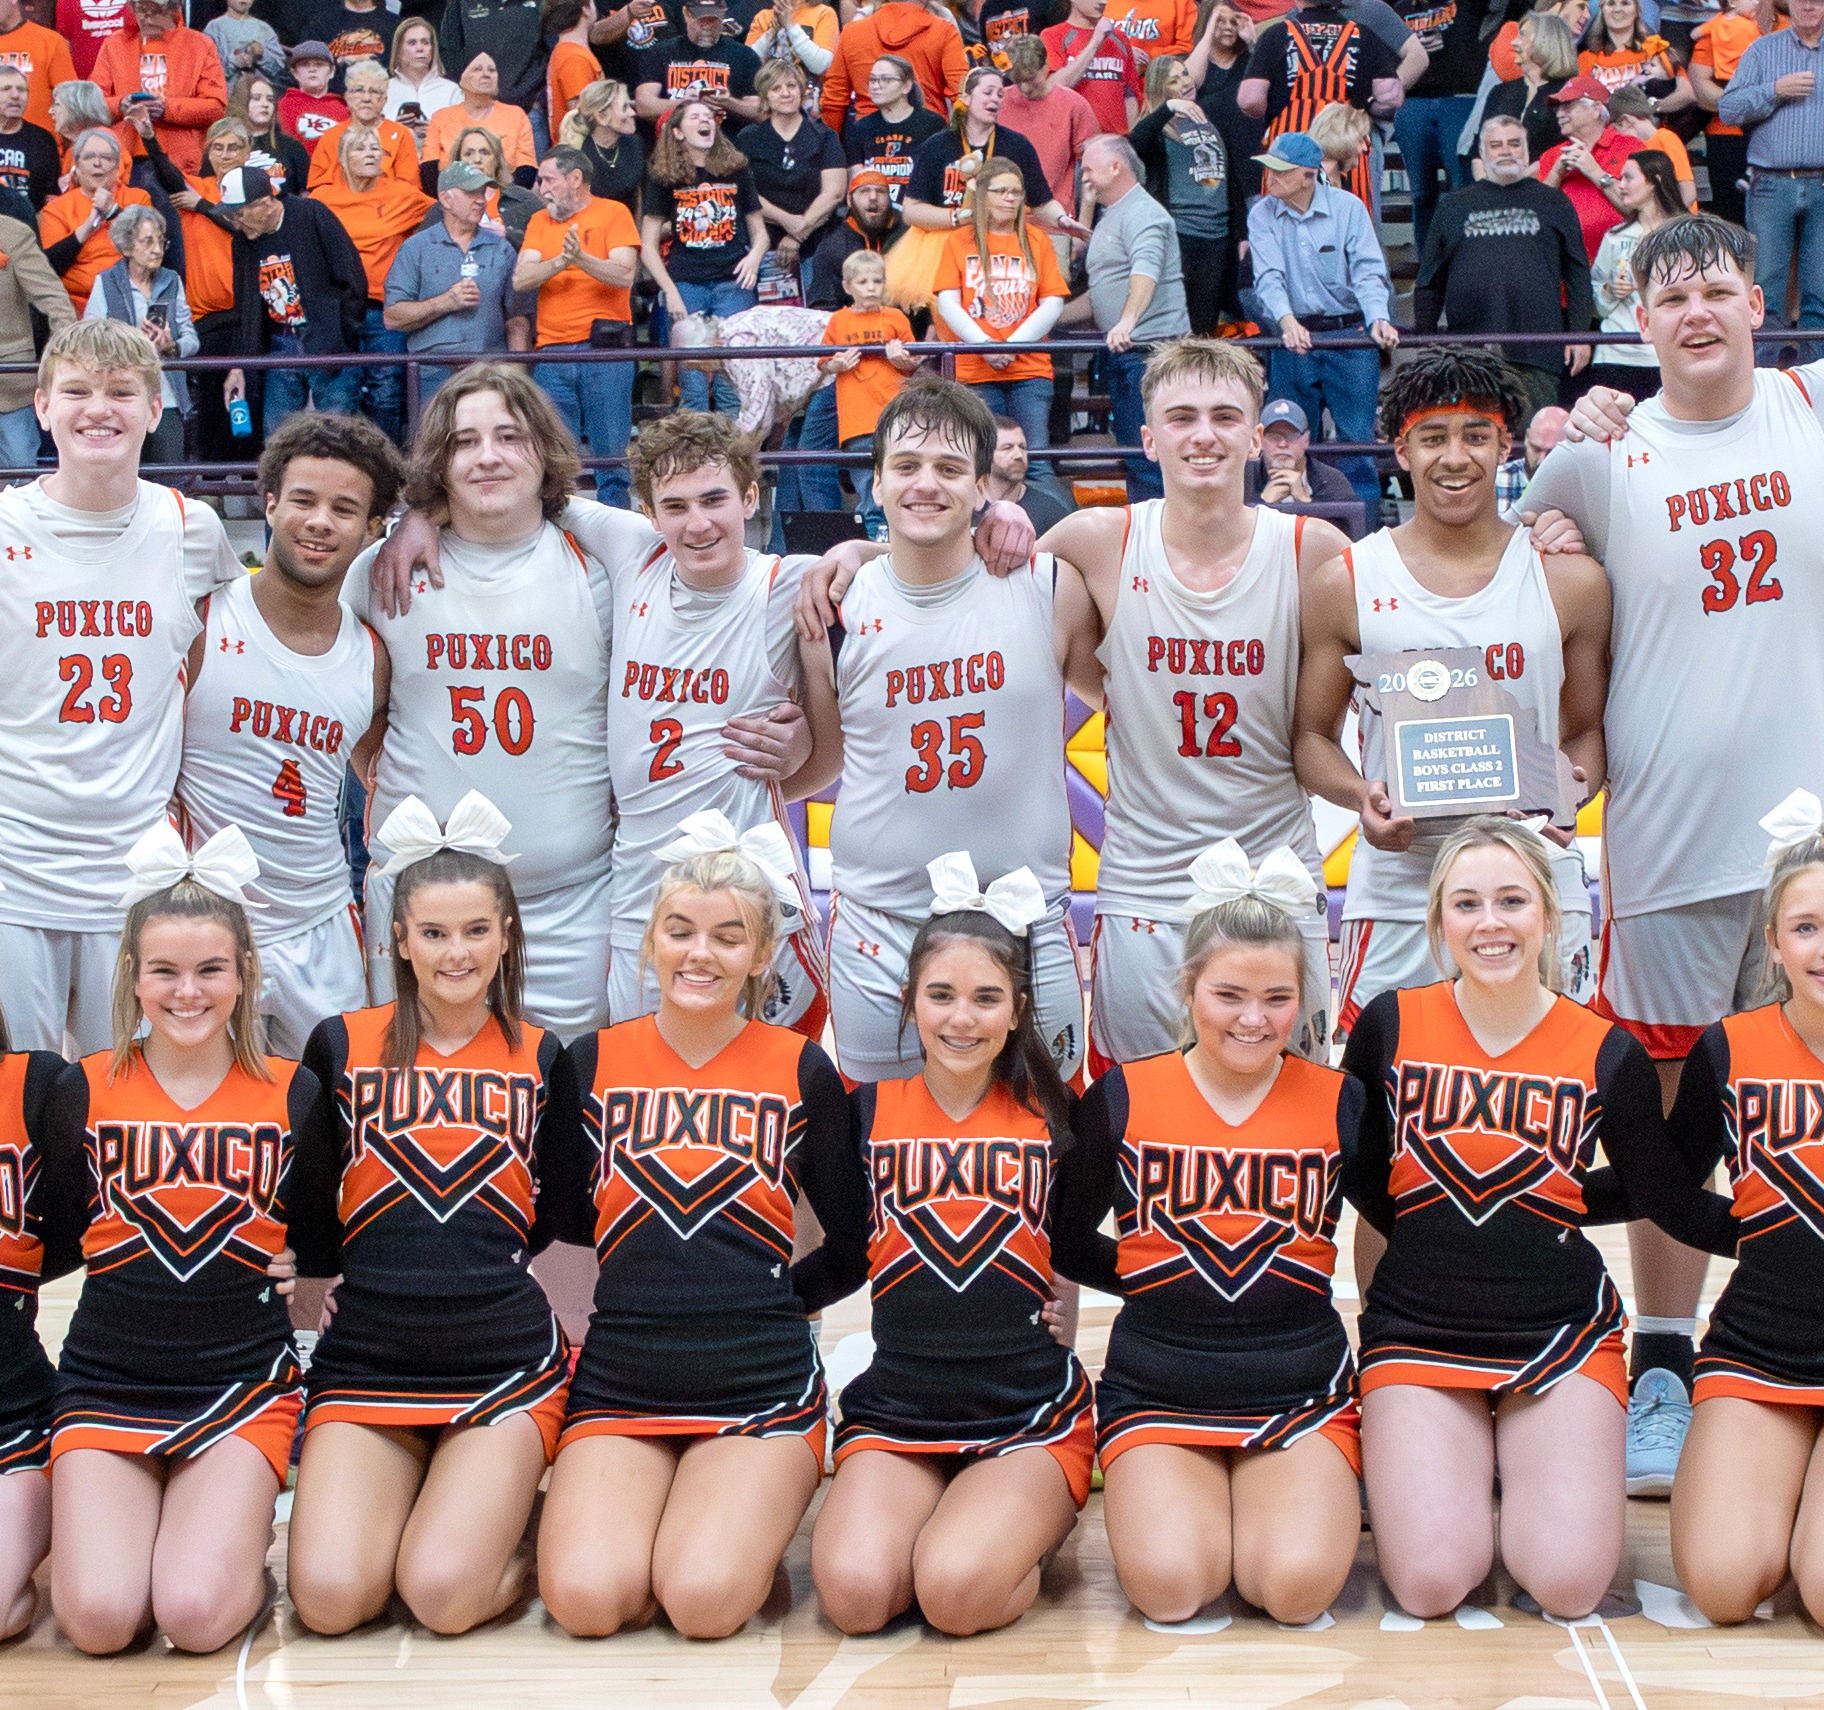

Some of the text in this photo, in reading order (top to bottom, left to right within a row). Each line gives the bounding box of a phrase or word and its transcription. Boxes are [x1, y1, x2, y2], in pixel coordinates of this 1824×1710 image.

[1665, 470, 1792, 532] PUXICO
[1699, 529, 1784, 616] 32
[35, 600, 152, 637] PUXICO
[426, 633, 552, 671] PUXICO
[621, 660, 729, 705] PUXICO
[885, 650, 1005, 707] PUXICO
[1147, 635, 1265, 676] PUXICO
[1379, 667, 1478, 693] 20 26
[58, 654, 133, 723] 23
[229, 696, 343, 755] PUXICO
[446, 685, 536, 756] 50
[648, 718, 684, 783] 2
[1171, 690, 1243, 758] 12
[1424, 729, 1486, 743] DISTRICT
[904, 710, 988, 794] 35
[1413, 745, 1501, 760] BASKETBALL
[1413, 760, 1503, 777] BOYS CLASS 2
[271, 759, 307, 817] 4
[1417, 776, 1502, 793] FIRST PLACE
[351, 1067, 538, 1168] PUXICO
[599, 1088, 789, 1191] PUXICO
[1397, 1062, 1585, 1176] PUXICO
[96, 1121, 278, 1220] PUXICO
[869, 1138, 1049, 1242] PUXICO
[1136, 1142, 1326, 1240] PUXICO
